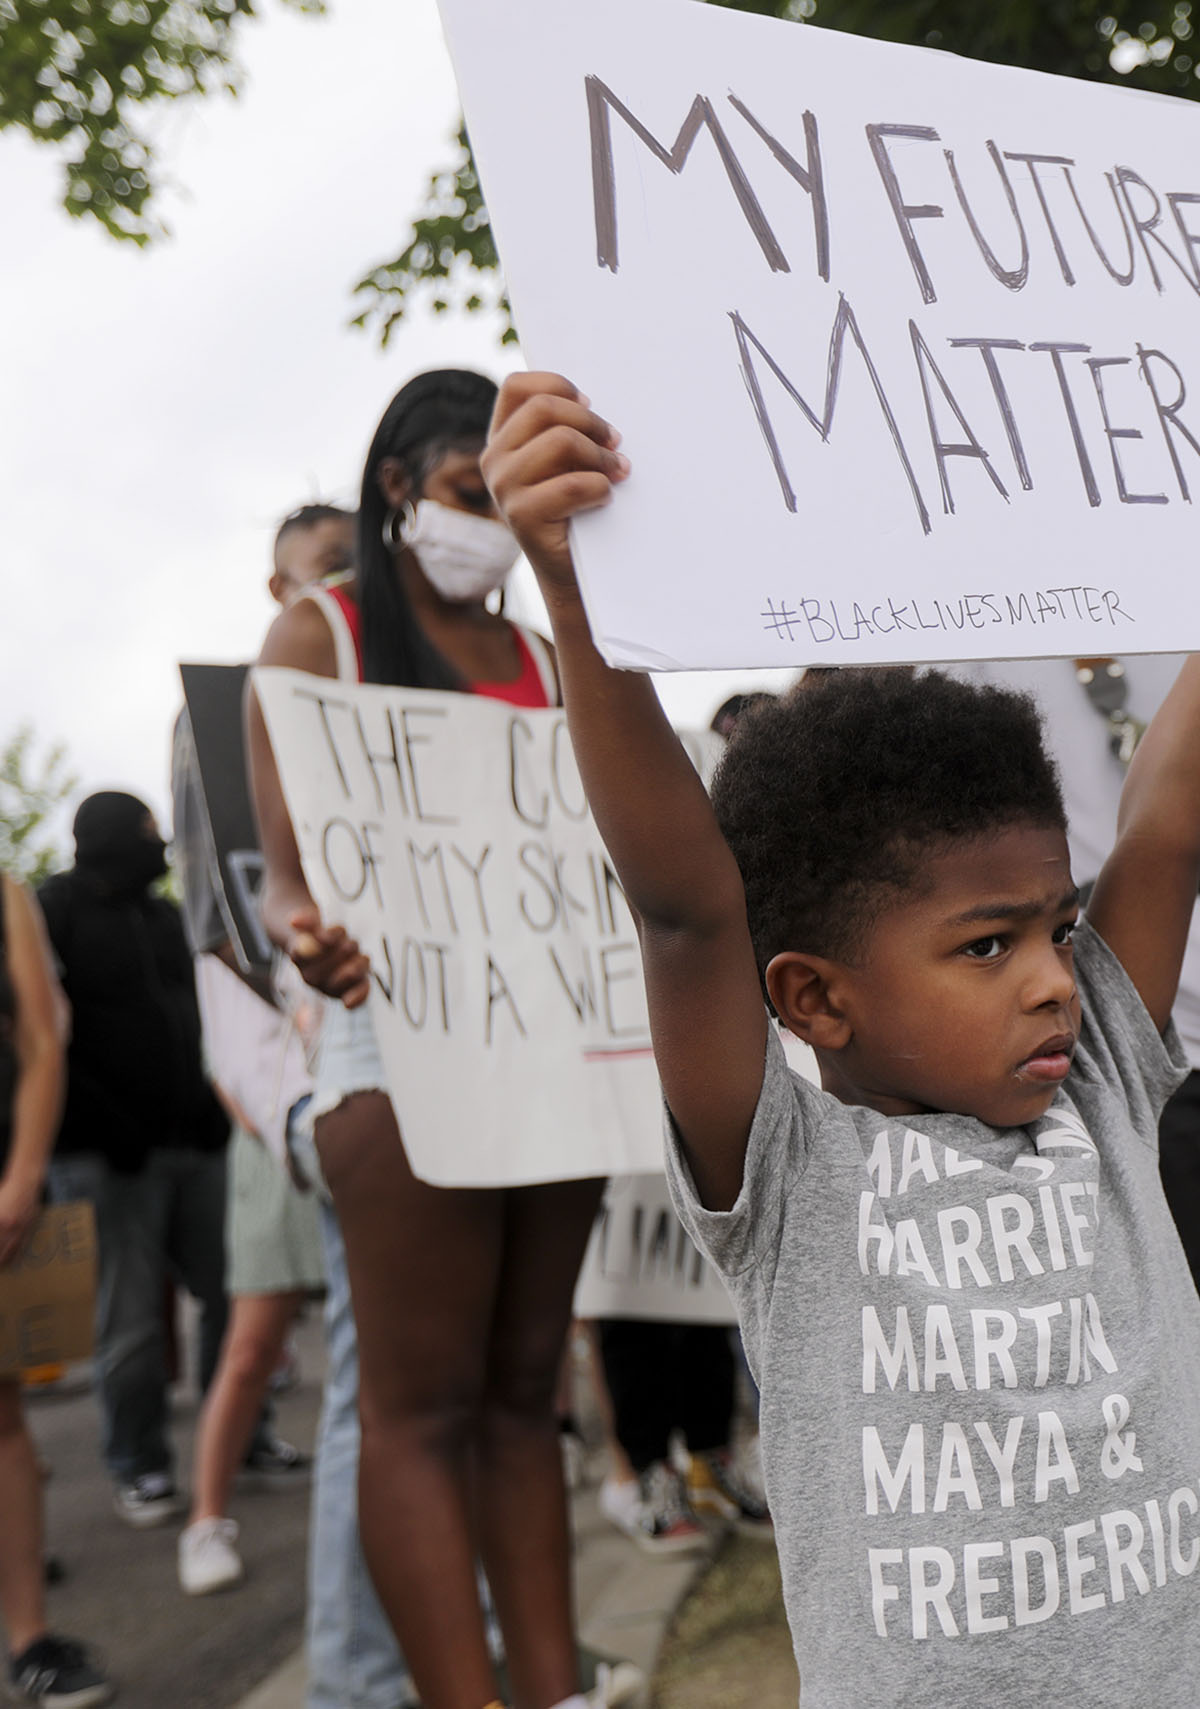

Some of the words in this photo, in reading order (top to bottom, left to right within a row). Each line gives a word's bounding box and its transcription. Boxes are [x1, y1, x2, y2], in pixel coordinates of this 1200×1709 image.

[585, 74, 829, 283] MY
[760, 586, 1136, 643] #BLACKLIVESMATTER
[291, 687, 461, 825] THE
[320, 816, 386, 912] OF
[405, 840, 490, 937] MY
[369, 934, 450, 1035] NOT
[484, 953, 528, 1047] A
[862, 1293, 1118, 1394] MARTIN
[862, 1410, 1081, 1516] MAYA
[1101, 1393, 1144, 1480] &
